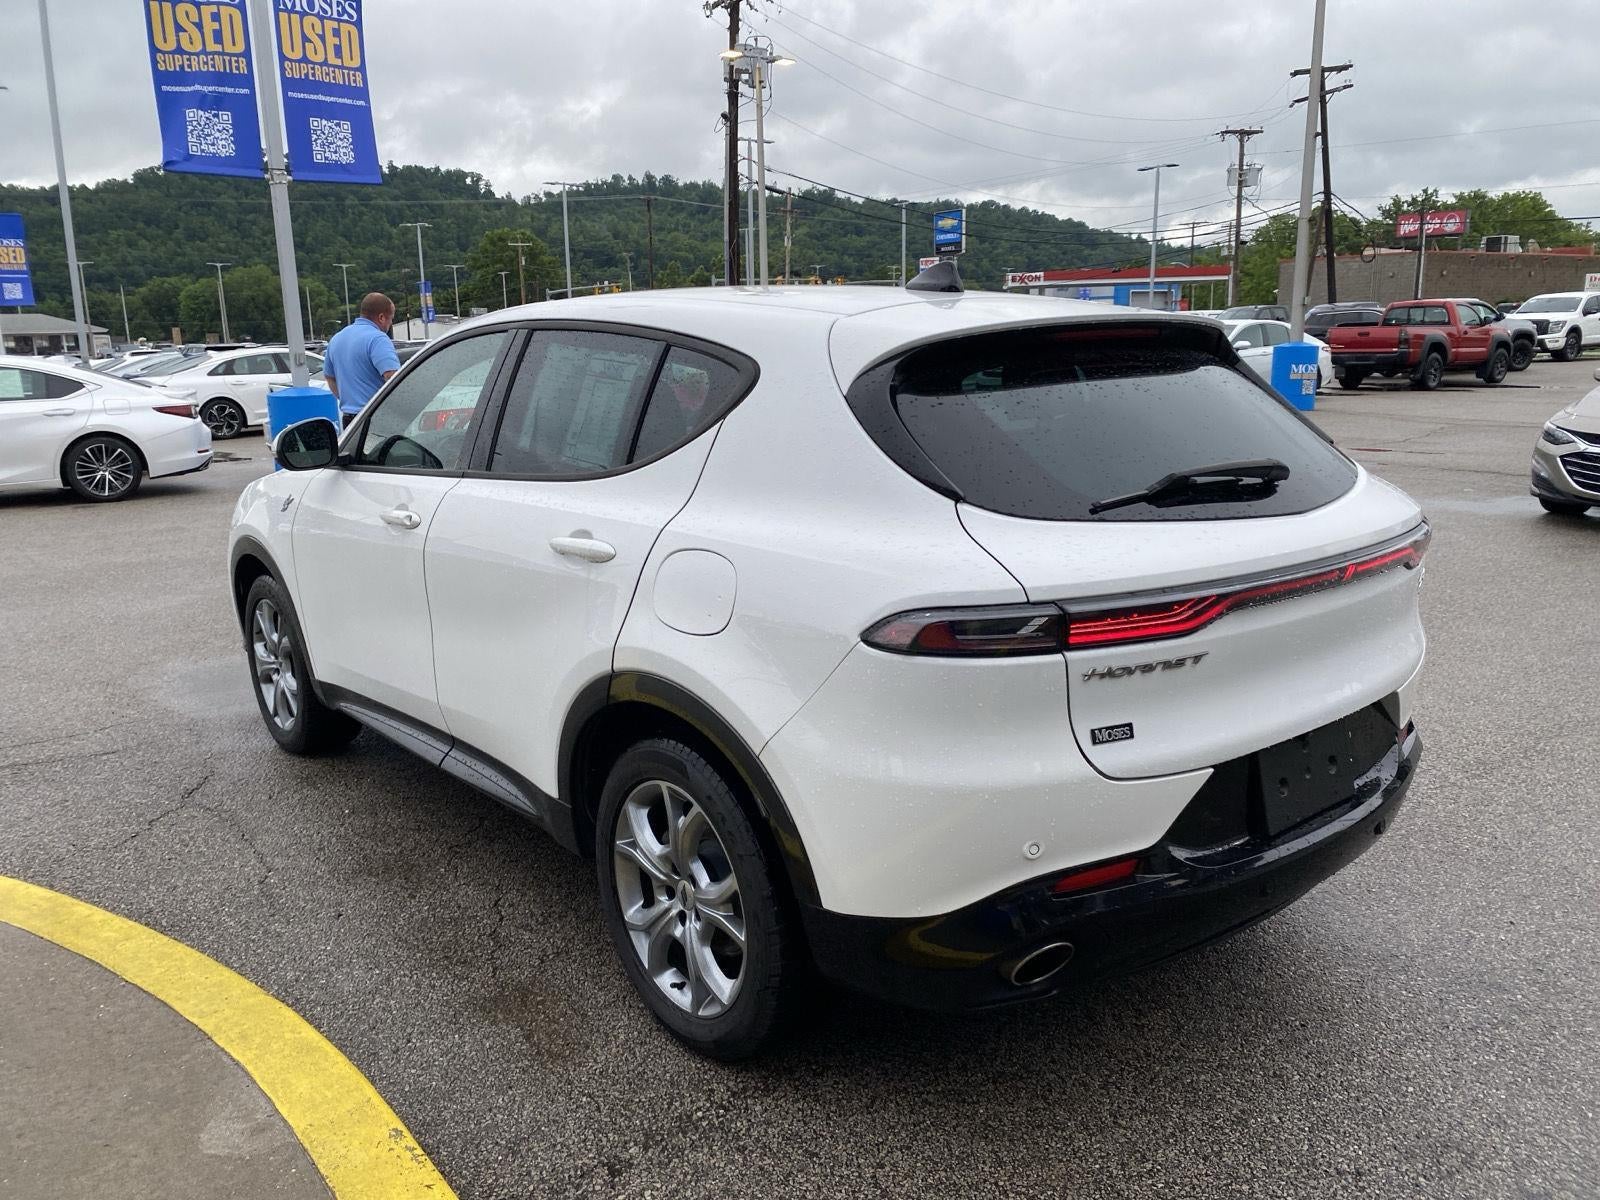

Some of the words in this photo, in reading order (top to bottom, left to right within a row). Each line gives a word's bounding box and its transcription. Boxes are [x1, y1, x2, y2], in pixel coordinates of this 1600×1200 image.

[279, 0, 358, 23] MOSES
[148, 1, 247, 54] USED
[279, 11, 362, 68] USED
[156, 52, 248, 75] SUPERCENTER
[284, 60, 364, 88] SUPERCENTER
[161, 83, 250, 95] mosesusedsupercenter.com
[287, 91, 366, 107] mosesusedsupercenter.com
[1010, 273, 1041, 285] EXXON
